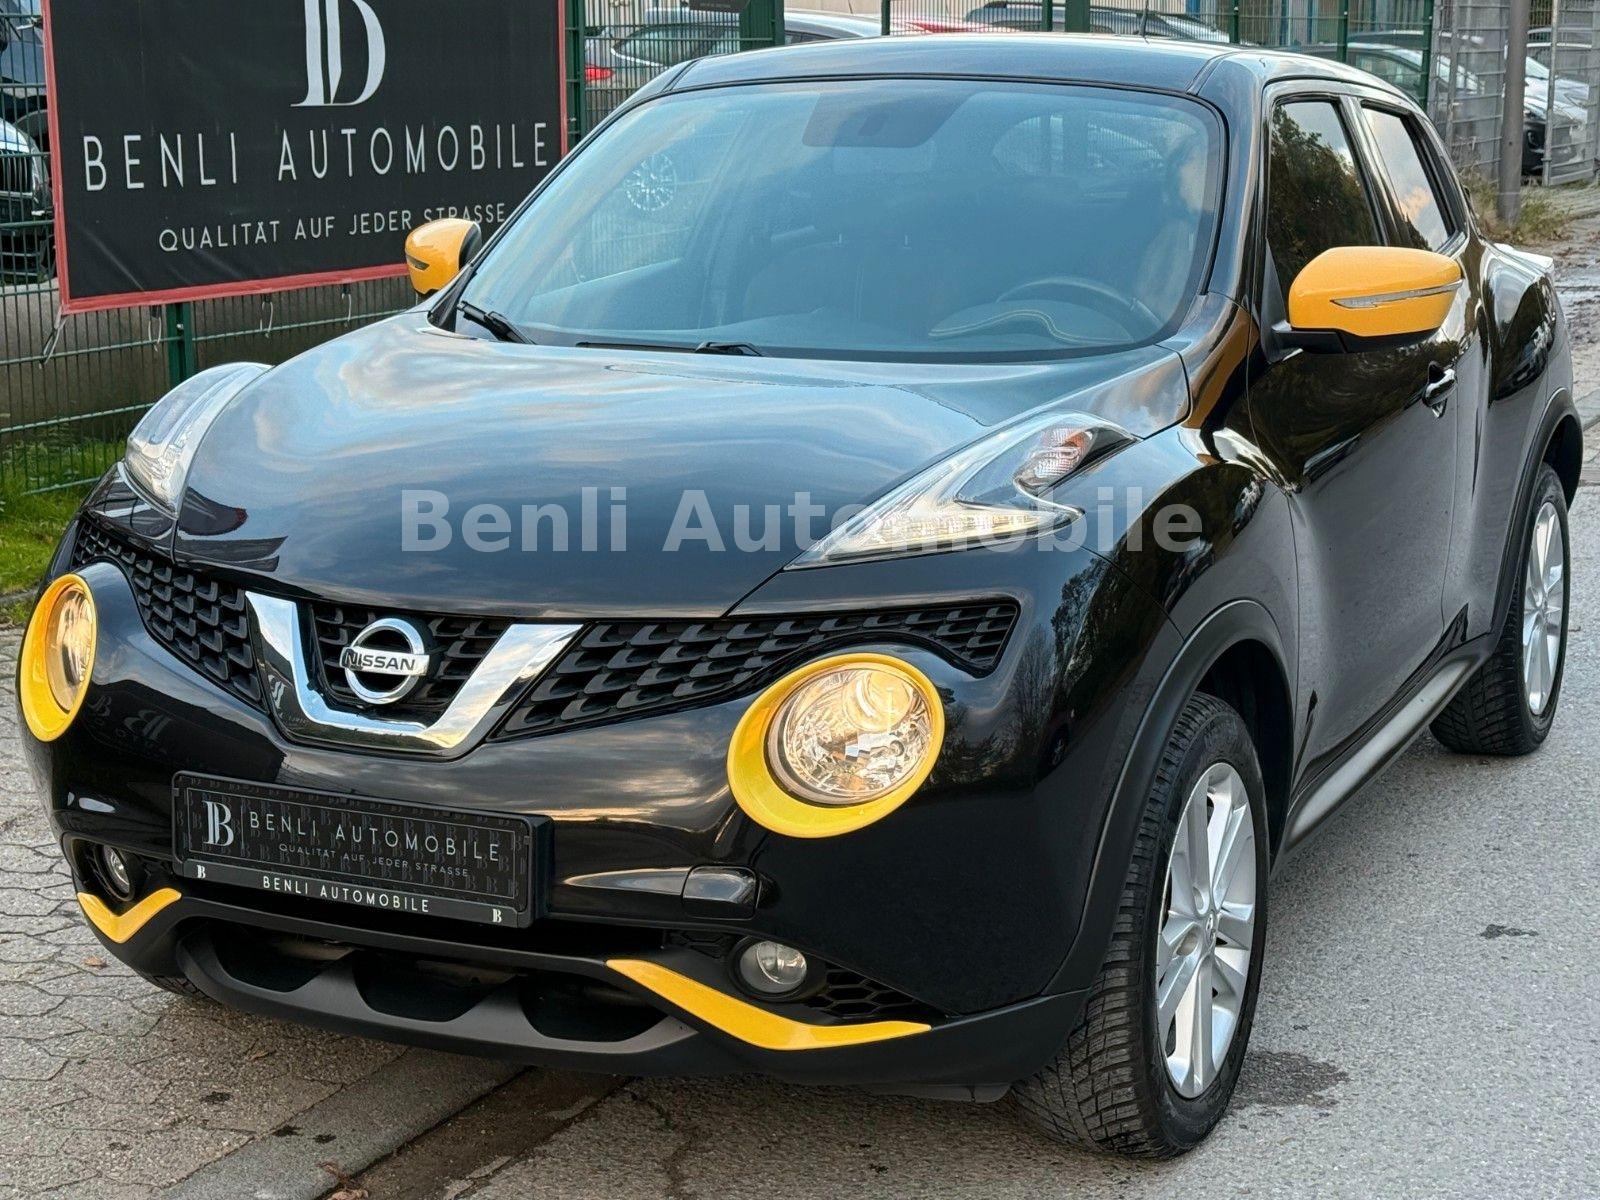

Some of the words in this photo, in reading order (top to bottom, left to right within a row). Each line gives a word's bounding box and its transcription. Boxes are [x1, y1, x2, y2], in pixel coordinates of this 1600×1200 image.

[83, 132, 239, 191] BENLI
[277, 122, 548, 183] AUTOMOBILE
[159, 220, 280, 252] QUALITÄT
[294, 216, 335, 243] AUF
[348, 209, 412, 236] JEDER
[344, 649, 415, 671] NISSAN
[250, 811, 316, 837] BENLI
[335, 823, 499, 862] AUTOMOBILE
[343, 852, 365, 862] AUF
[372, 857, 409, 869] JEDER
[415, 862, 470, 878] STRASSE
[263, 875, 309, 895] BENLI
[320, 884, 429, 913] AUTOMOBILE
